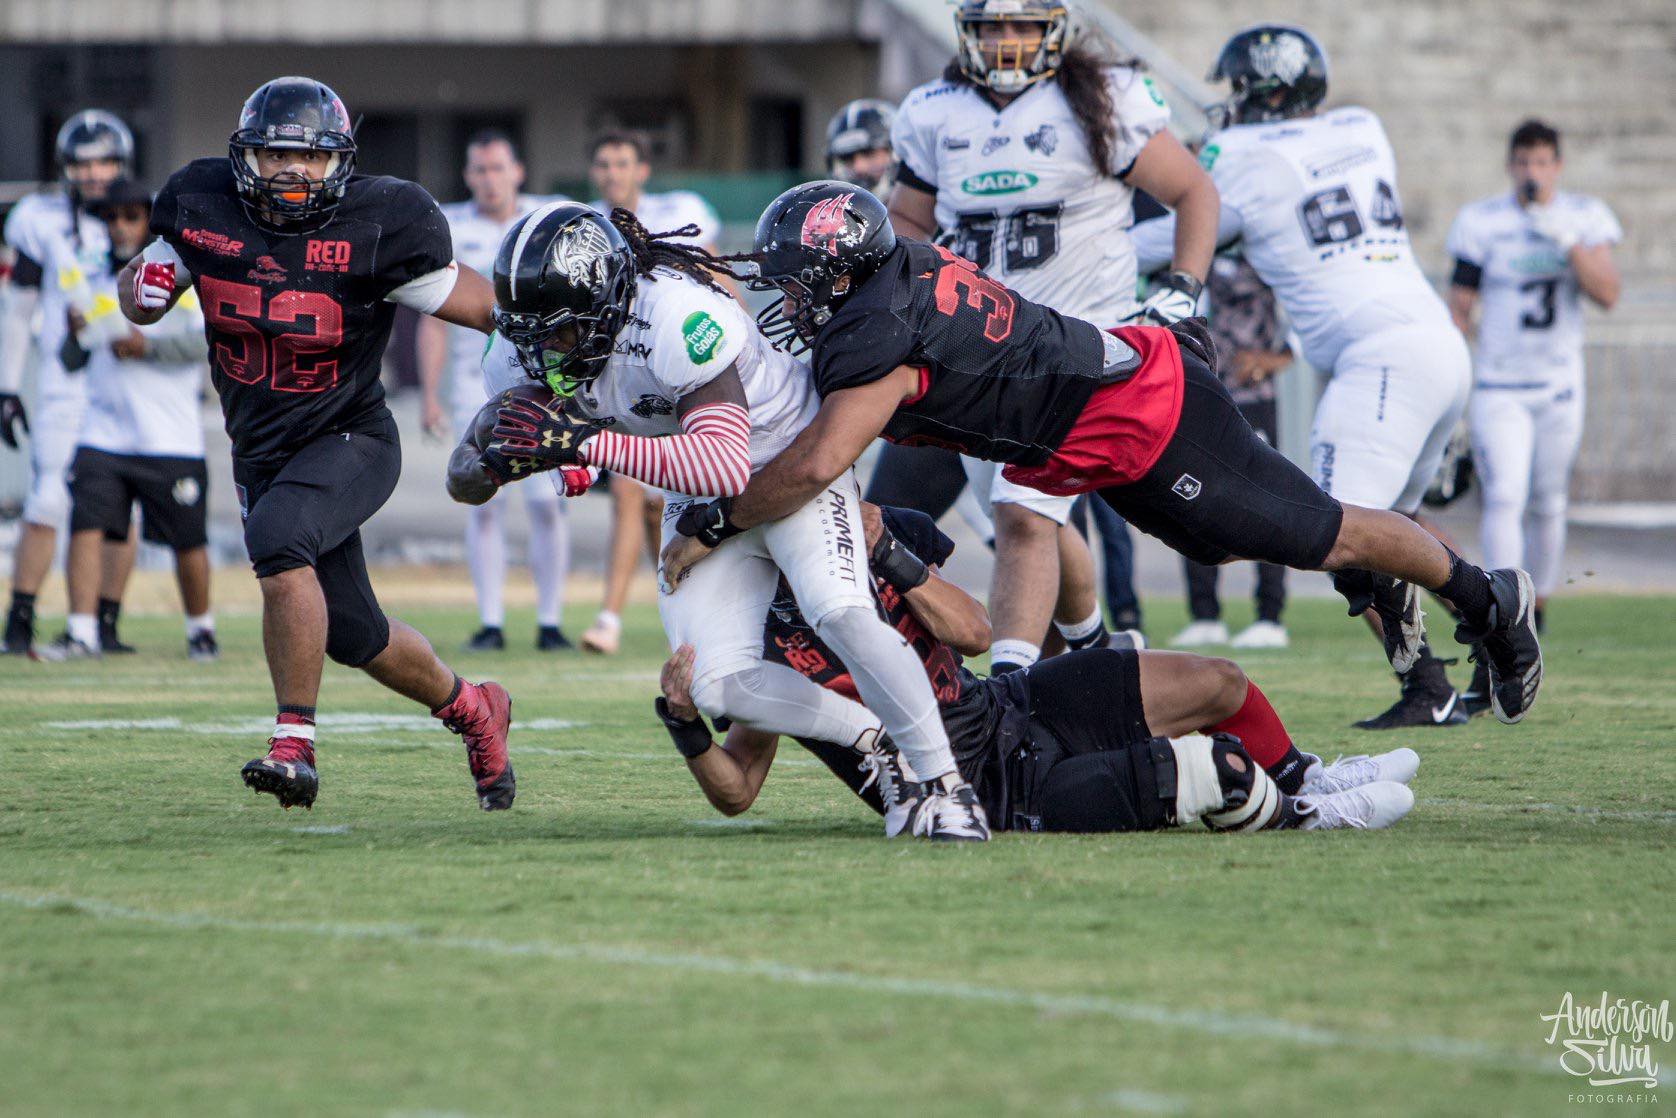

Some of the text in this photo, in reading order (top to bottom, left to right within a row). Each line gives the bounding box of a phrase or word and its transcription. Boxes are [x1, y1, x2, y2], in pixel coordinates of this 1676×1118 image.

[966, 174, 1031, 191] SADA
[1299, 178, 1403, 246] 64
[305, 240, 351, 264] RED
[931, 243, 1015, 343] 3
[1519, 276, 1560, 330] 3
[199, 274, 343, 393] 52
[627, 343, 652, 360] MRV
[685, 318, 711, 344] Frutos
[817, 498, 835, 576] academia
[828, 489, 857, 587] PRIMEFIT
